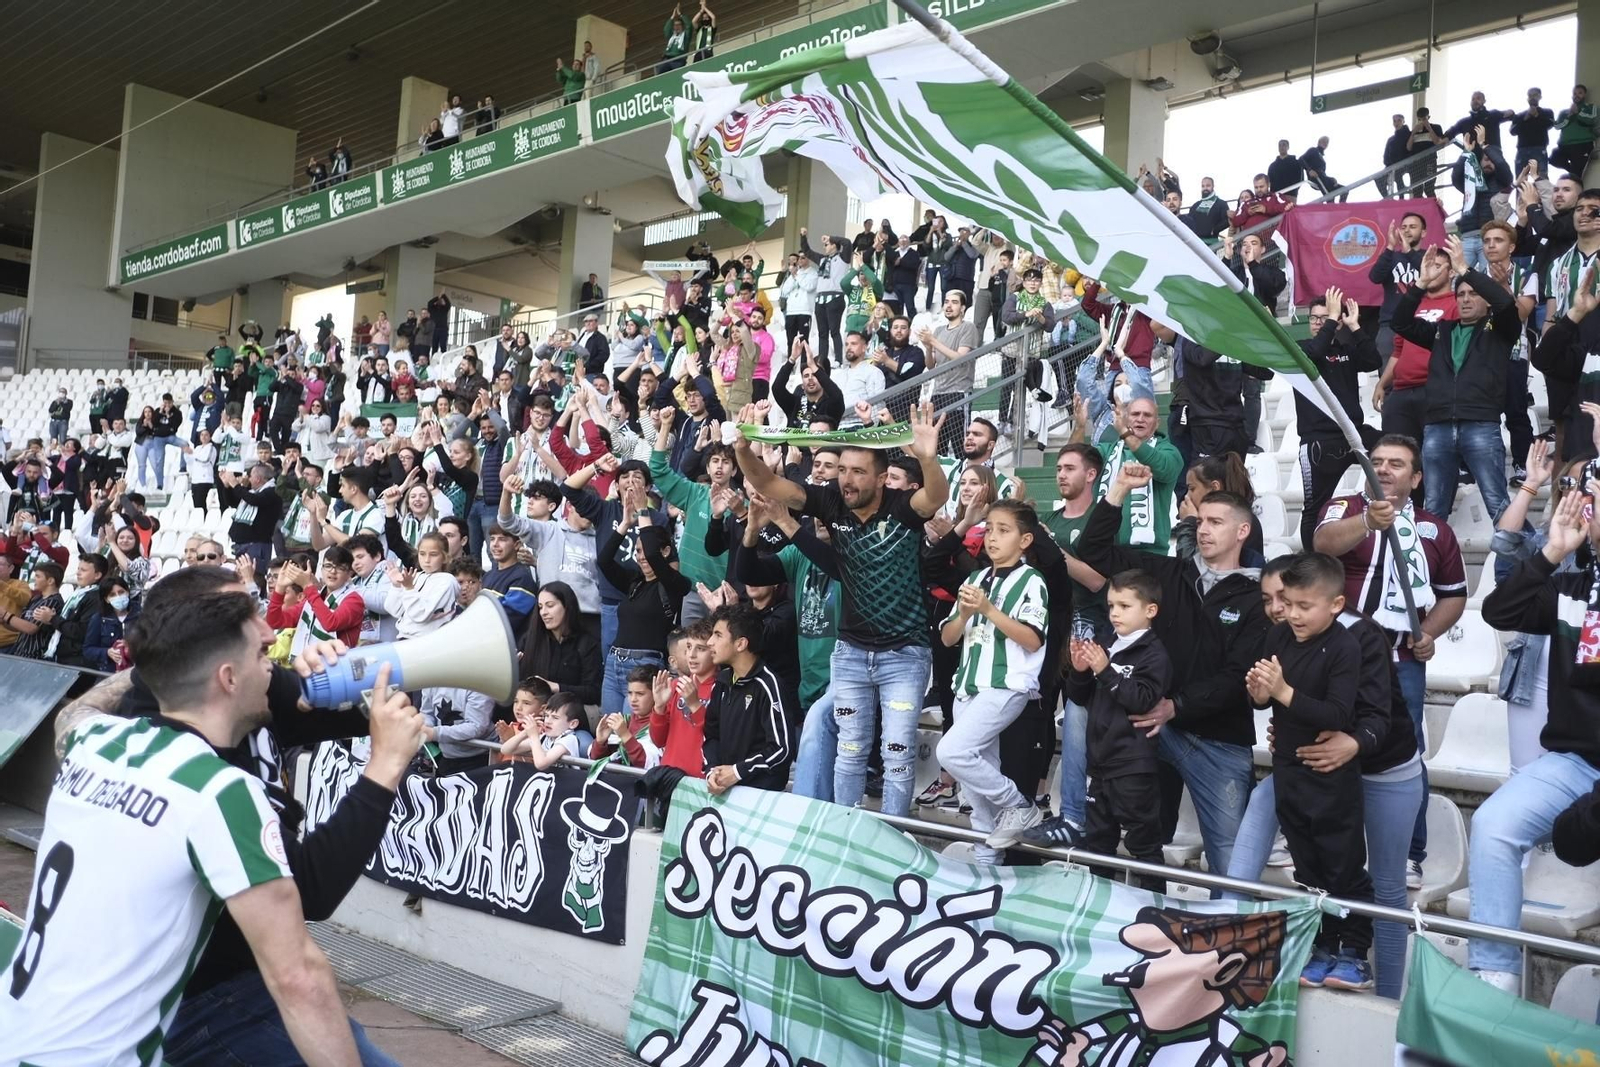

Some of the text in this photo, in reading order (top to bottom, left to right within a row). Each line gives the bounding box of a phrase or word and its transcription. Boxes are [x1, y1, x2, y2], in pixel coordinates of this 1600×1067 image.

[1412, 75, 1422, 90] 4
[1315, 97, 1324, 111] 3
[531, 117, 565, 138] AYUNTAMIENTO
[465, 141, 496, 160] AYUNTAMIENTO
[532, 140, 539, 150] DE
[465, 162, 472, 171] DE
[344, 186, 370, 201] Diputación
[295, 202, 320, 217] Diputación
[345, 201, 352, 211] de
[252, 217, 274, 230] Diputación
[296, 217, 303, 226] de
[125, 234, 222, 279] tienda.cordobacf.com
[559, 564, 592, 577] adid
[53, 758, 169, 828] SAMU DELGADO
[9, 840, 75, 1001] 8
[664, 807, 1060, 1038] Sección
